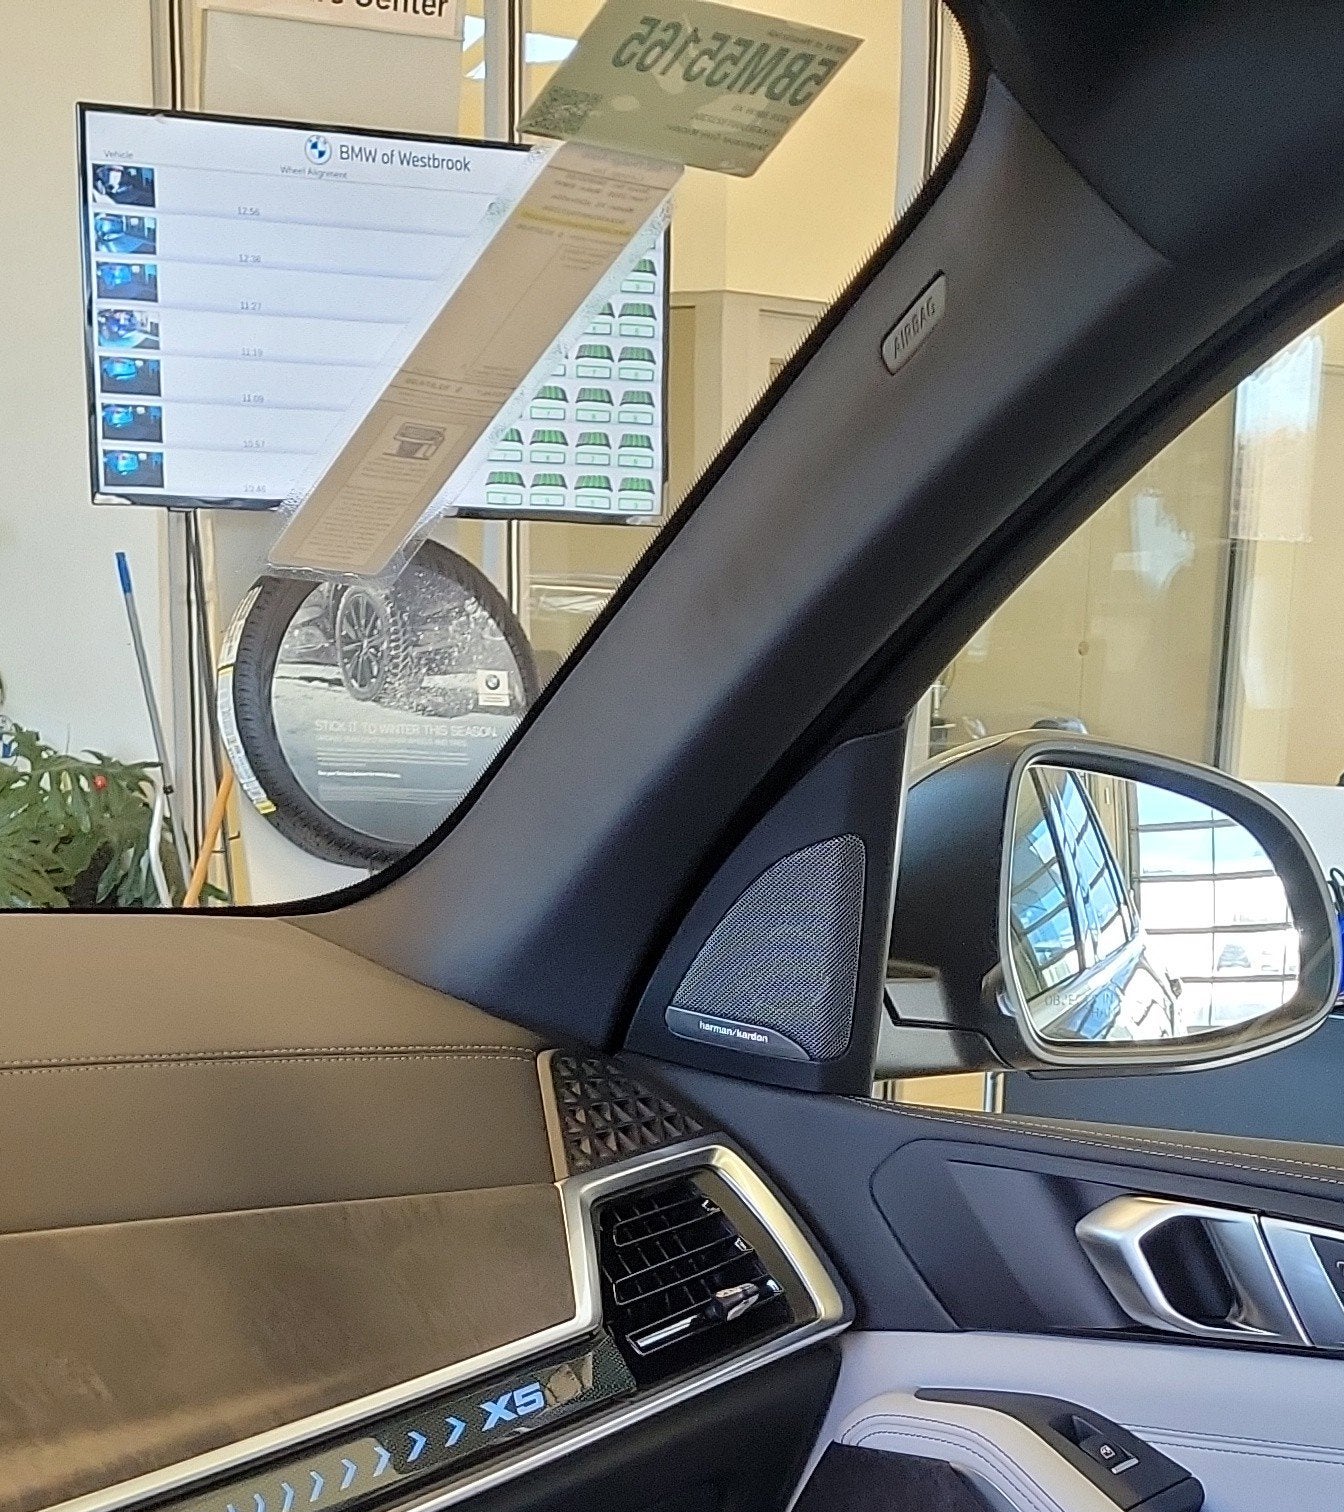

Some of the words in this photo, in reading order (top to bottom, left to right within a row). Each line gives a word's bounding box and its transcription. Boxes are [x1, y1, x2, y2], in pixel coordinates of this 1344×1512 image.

[104, 149, 134, 159] Vehicle
[339, 143, 377, 165] BMW
[381, 147, 396, 165] of
[397, 150, 471, 173] Westbrook
[280, 166, 306, 176] Wheel
[307, 167, 348, 181] Alignment
[424, 724, 448, 736] THIS
[699, 1021, 769, 1043] harman/kardon
[481, 1382, 546, 1431] X5
